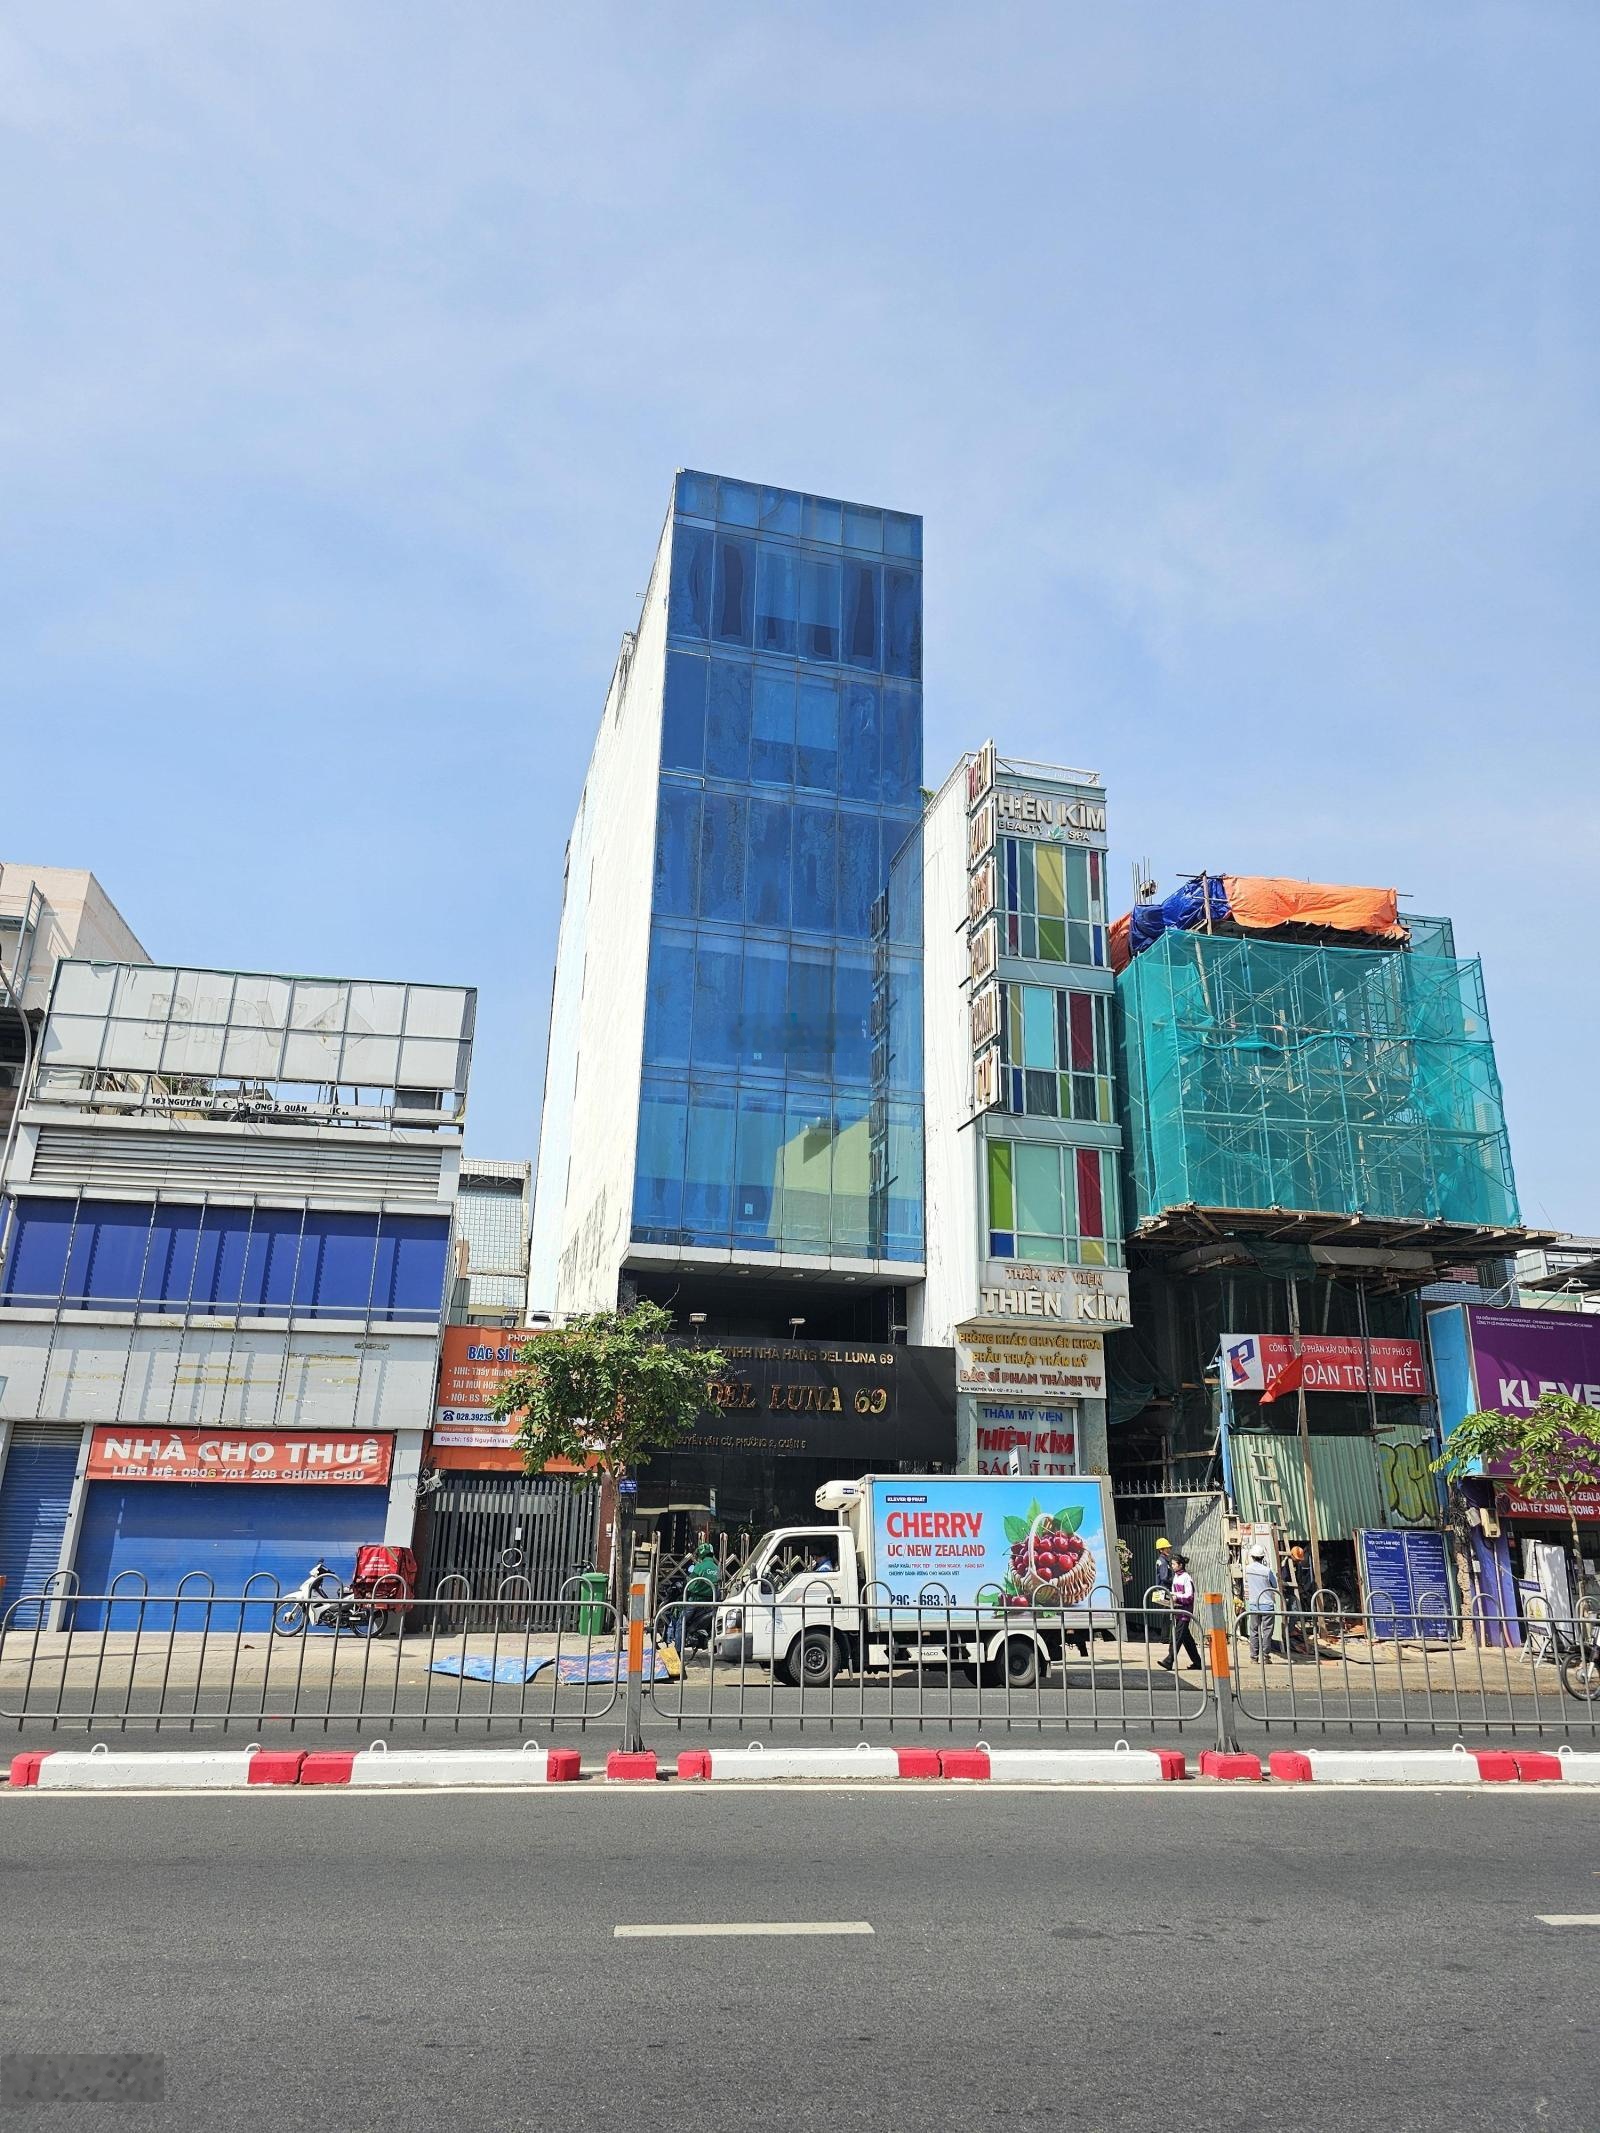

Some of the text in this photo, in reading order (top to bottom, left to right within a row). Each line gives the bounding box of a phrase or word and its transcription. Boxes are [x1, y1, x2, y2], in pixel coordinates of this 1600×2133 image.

[998, 820, 1090, 842] BEAUTY SPA
[980, 1285, 1062, 1317] THIÊN
[468, 1343, 493, 1361] BÁC
[1072, 1338, 1102, 1350] KHOA
[1269, 1342, 1287, 1352] CÔNG
[844, 1352, 877, 1364] LUNA
[879, 1353, 894, 1365] 69
[1002, 1372, 1037, 1385] PHAN
[1303, 1359, 1339, 1385] OÀN
[1391, 1360, 1422, 1387] HẾT
[452, 1380, 464, 1389] TAI
[706, 1381, 888, 1415] DEL LUNA 69
[103, 1434, 379, 1464] NHÀ CHO THUÊ
[112, 1464, 147, 1478] LIÊN
[152, 1466, 176, 1481] HỆ:
[181, 1468, 217, 1479] 0906
[222, 1468, 245, 1480] 701
[251, 1469, 277, 1480] 208
[281, 1467, 329, 1480] CHÍNH
[1544, 1503, 1566, 1515] SANG
[886, 1511, 983, 1538] CHERRY
[935, 1544, 985, 1557] ZEALAND
